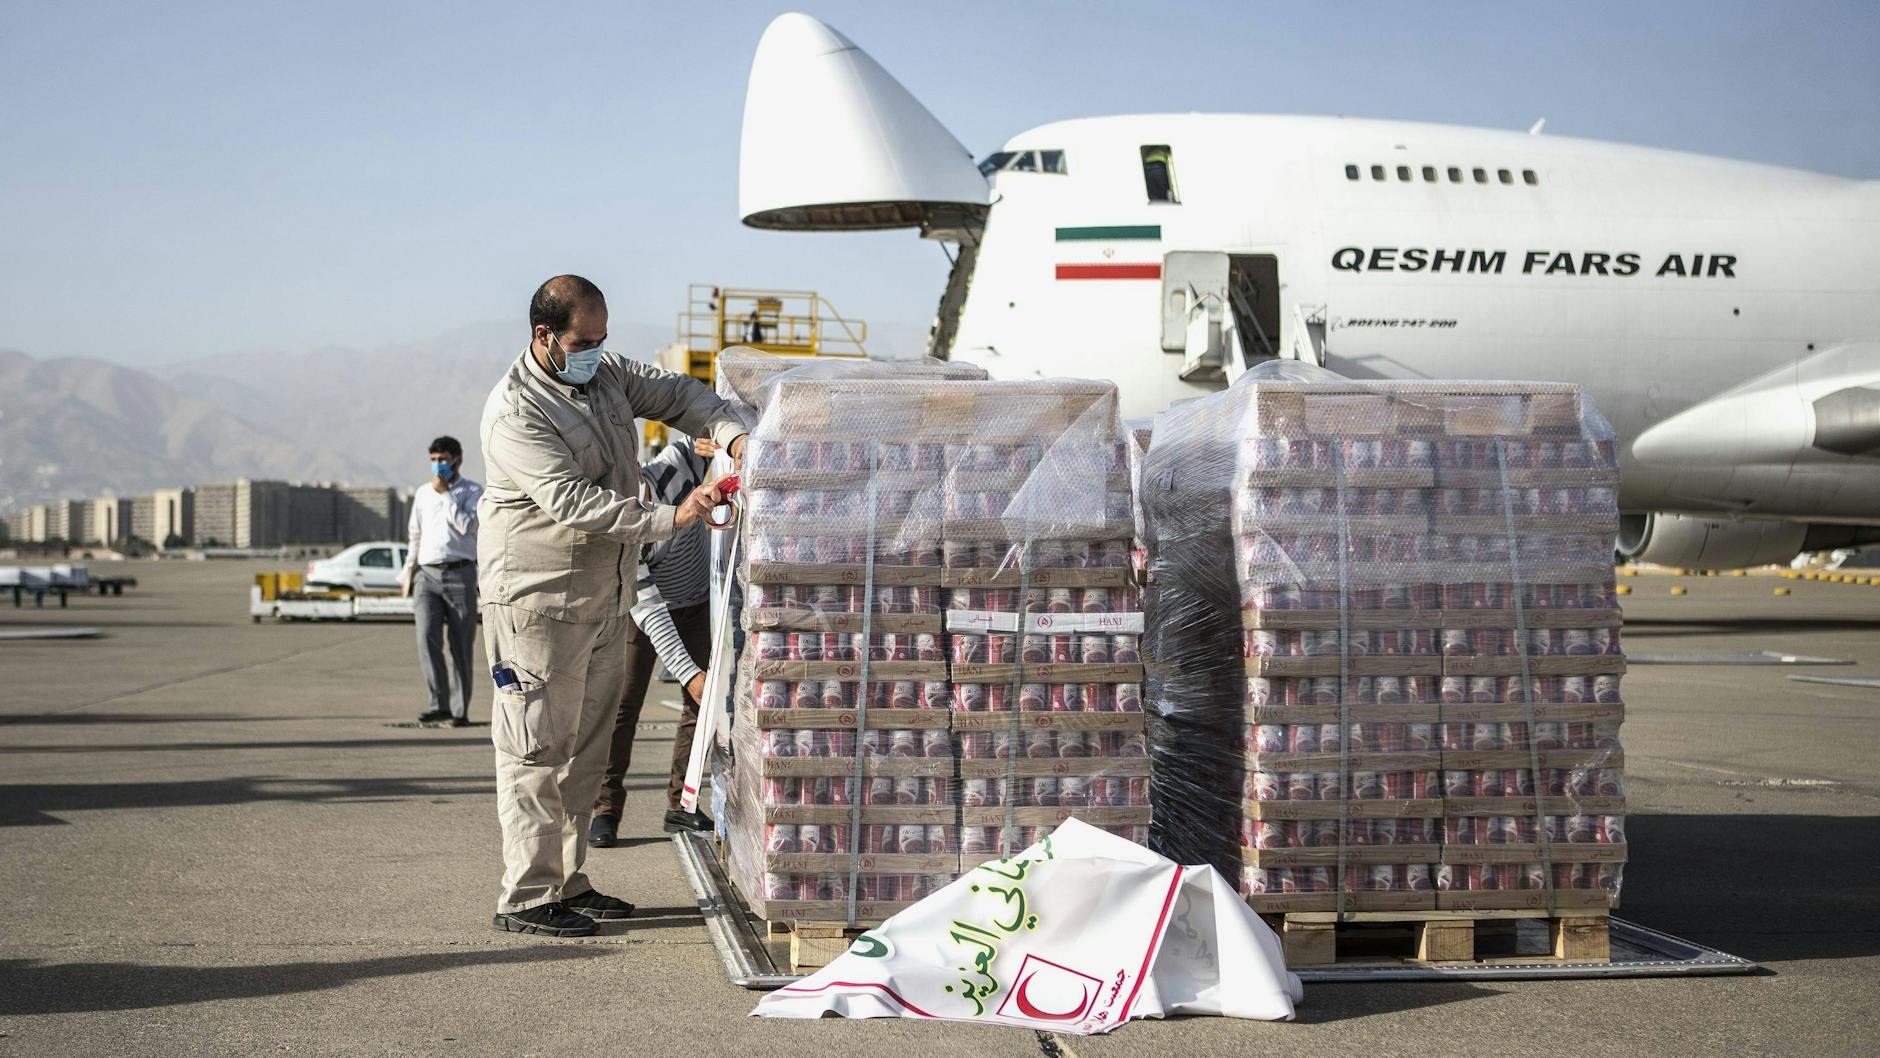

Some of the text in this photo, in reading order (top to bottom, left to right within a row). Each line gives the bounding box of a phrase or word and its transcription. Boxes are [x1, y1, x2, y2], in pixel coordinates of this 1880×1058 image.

[1332, 247, 1738, 279] QESHM FARS AIR
[1348, 319, 1400, 328] BOEING
[764, 572, 789, 581] HANI
[957, 577, 983, 586] HANI
[1099, 617, 1123, 626] HANI
[958, 666, 983, 675] HANI
